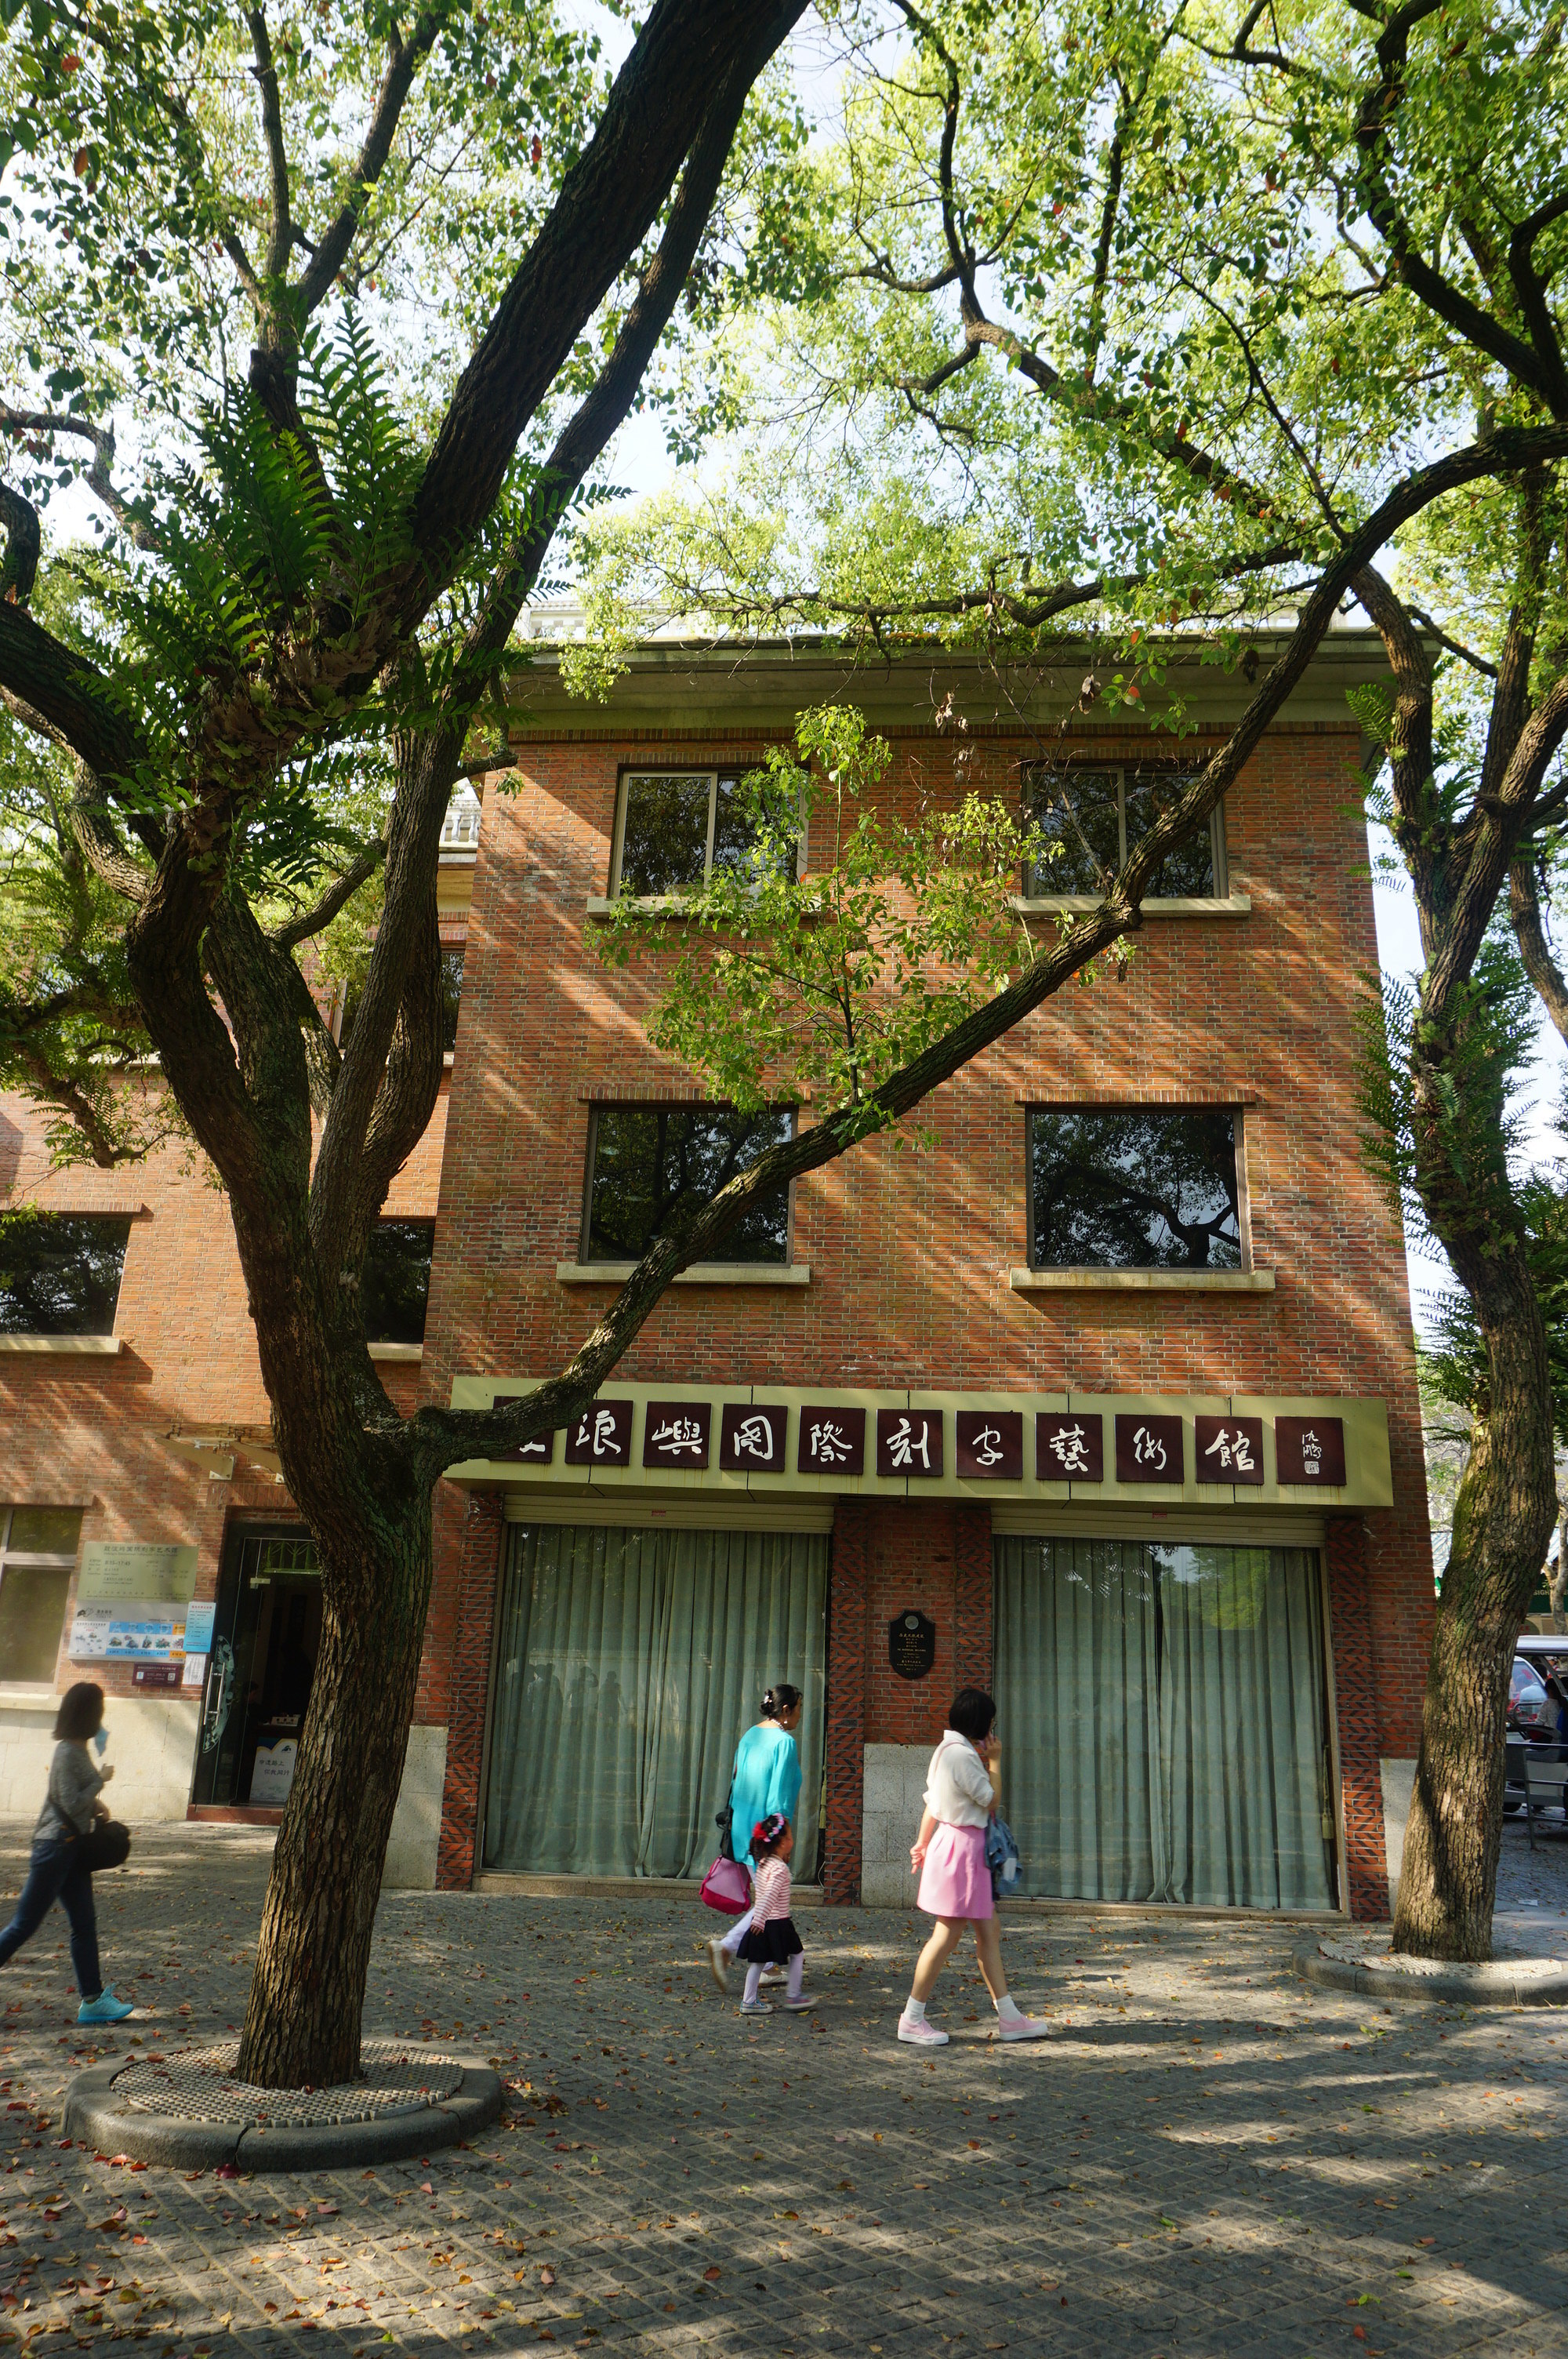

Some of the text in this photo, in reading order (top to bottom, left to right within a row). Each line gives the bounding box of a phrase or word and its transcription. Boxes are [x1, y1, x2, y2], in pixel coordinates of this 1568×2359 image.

[519, 1409, 1255, 1472] 浪嶼國際刻字藝術館
